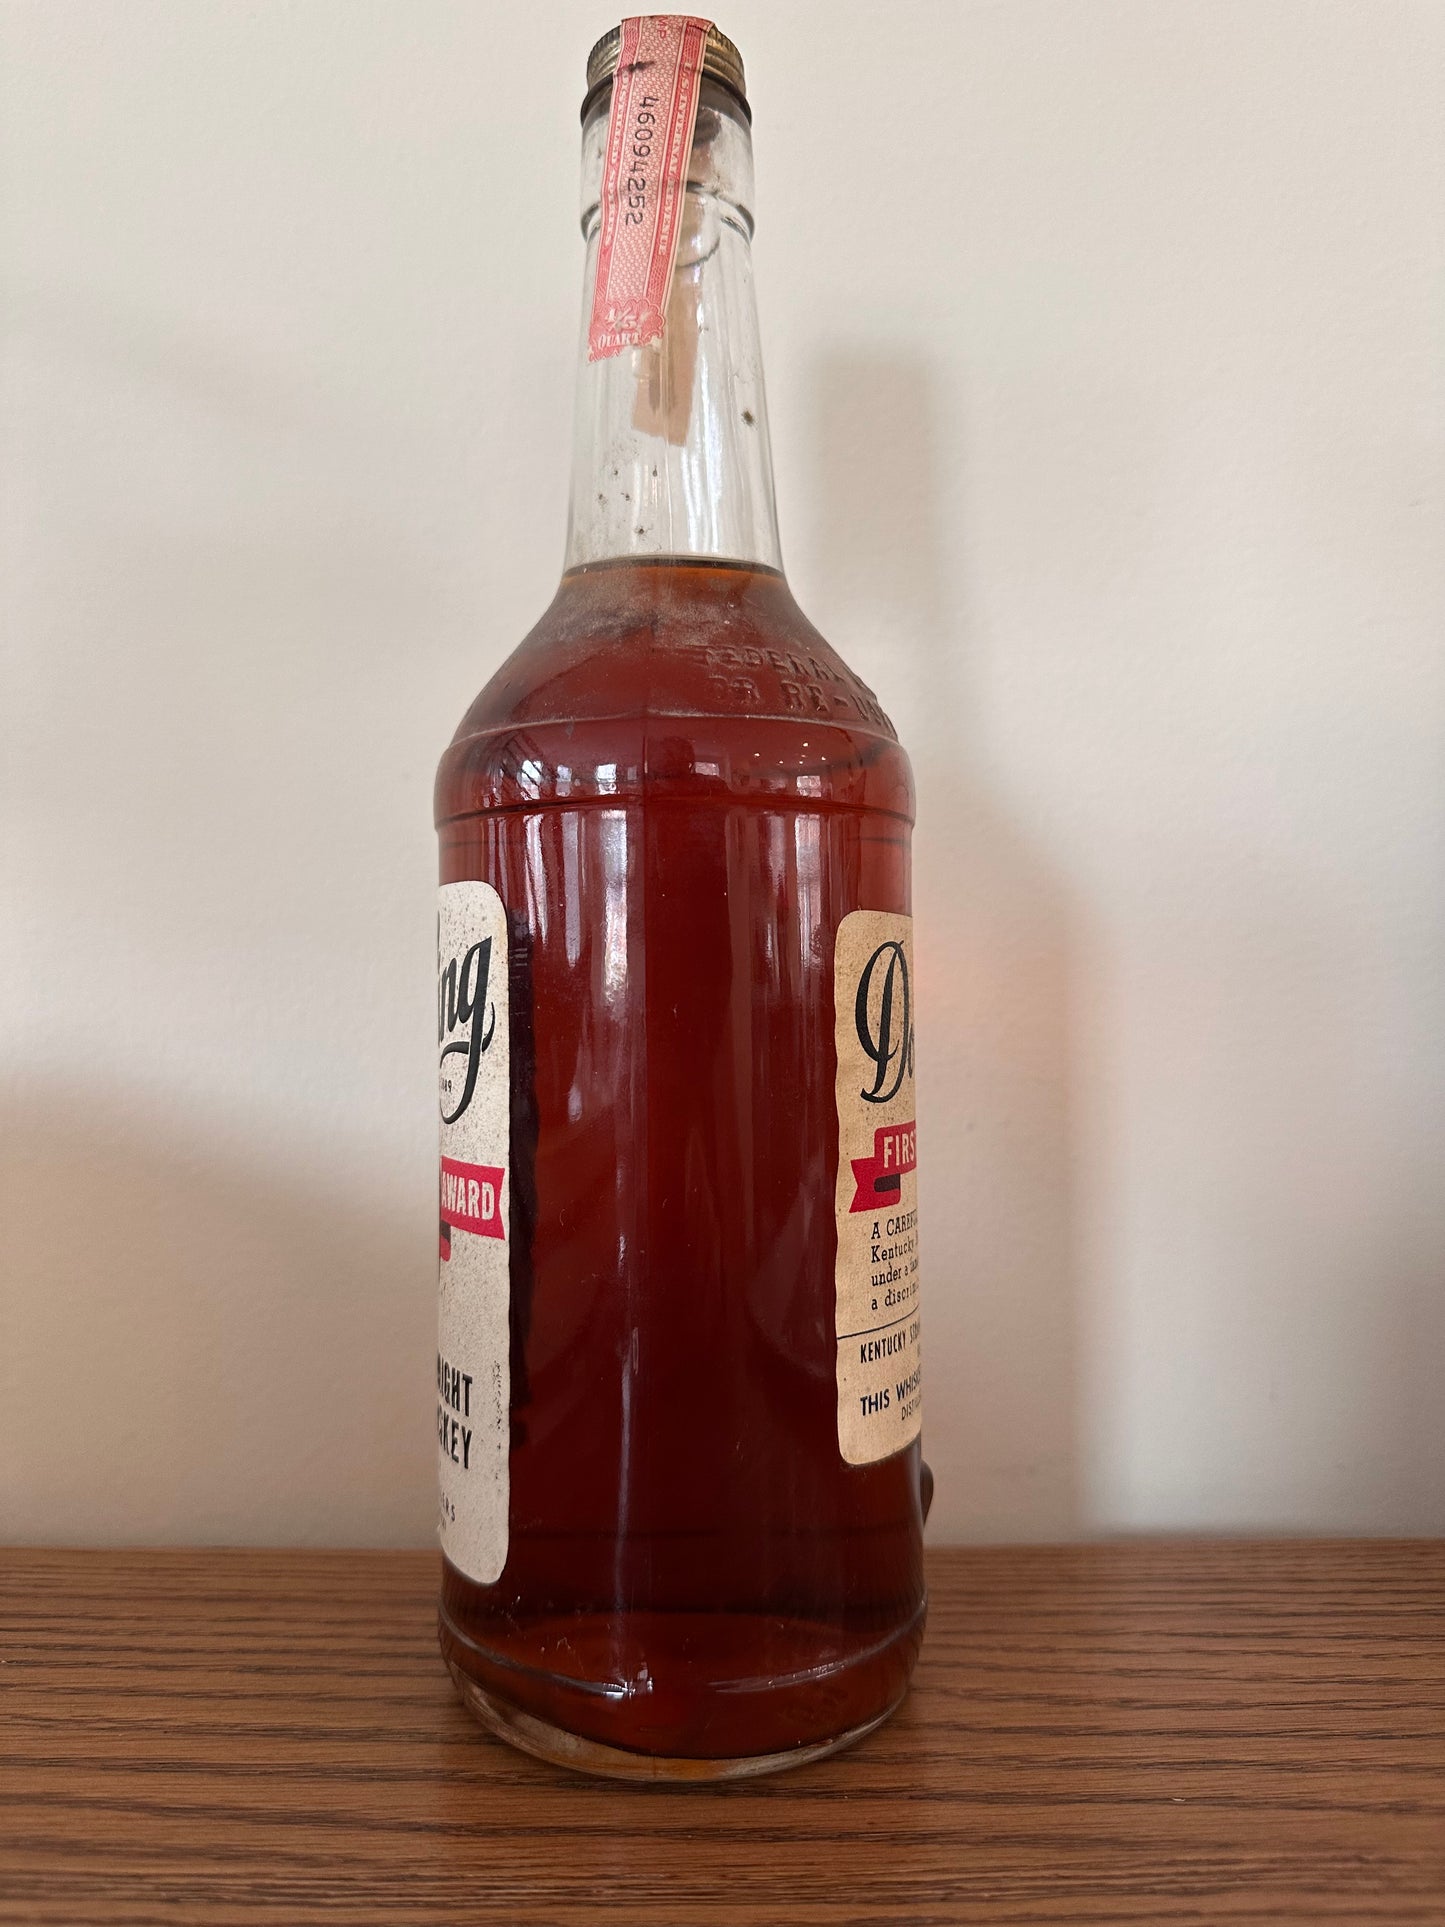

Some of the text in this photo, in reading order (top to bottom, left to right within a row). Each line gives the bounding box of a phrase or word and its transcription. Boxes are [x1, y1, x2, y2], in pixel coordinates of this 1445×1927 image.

[668, 92, 689, 174] INTERNAL
[625, 96, 660, 226] 46094252
[658, 176, 679, 256] REVENUE
[883, 1127, 917, 1169] FIRS
[441, 1170, 495, 1221] AWARD
[871, 1221, 881, 1240] A
[871, 1261, 902, 1287] under
[871, 1298, 879, 1311] a
[860, 1327, 907, 1364] KENTUCKY
[860, 1388, 891, 1417] THIS
